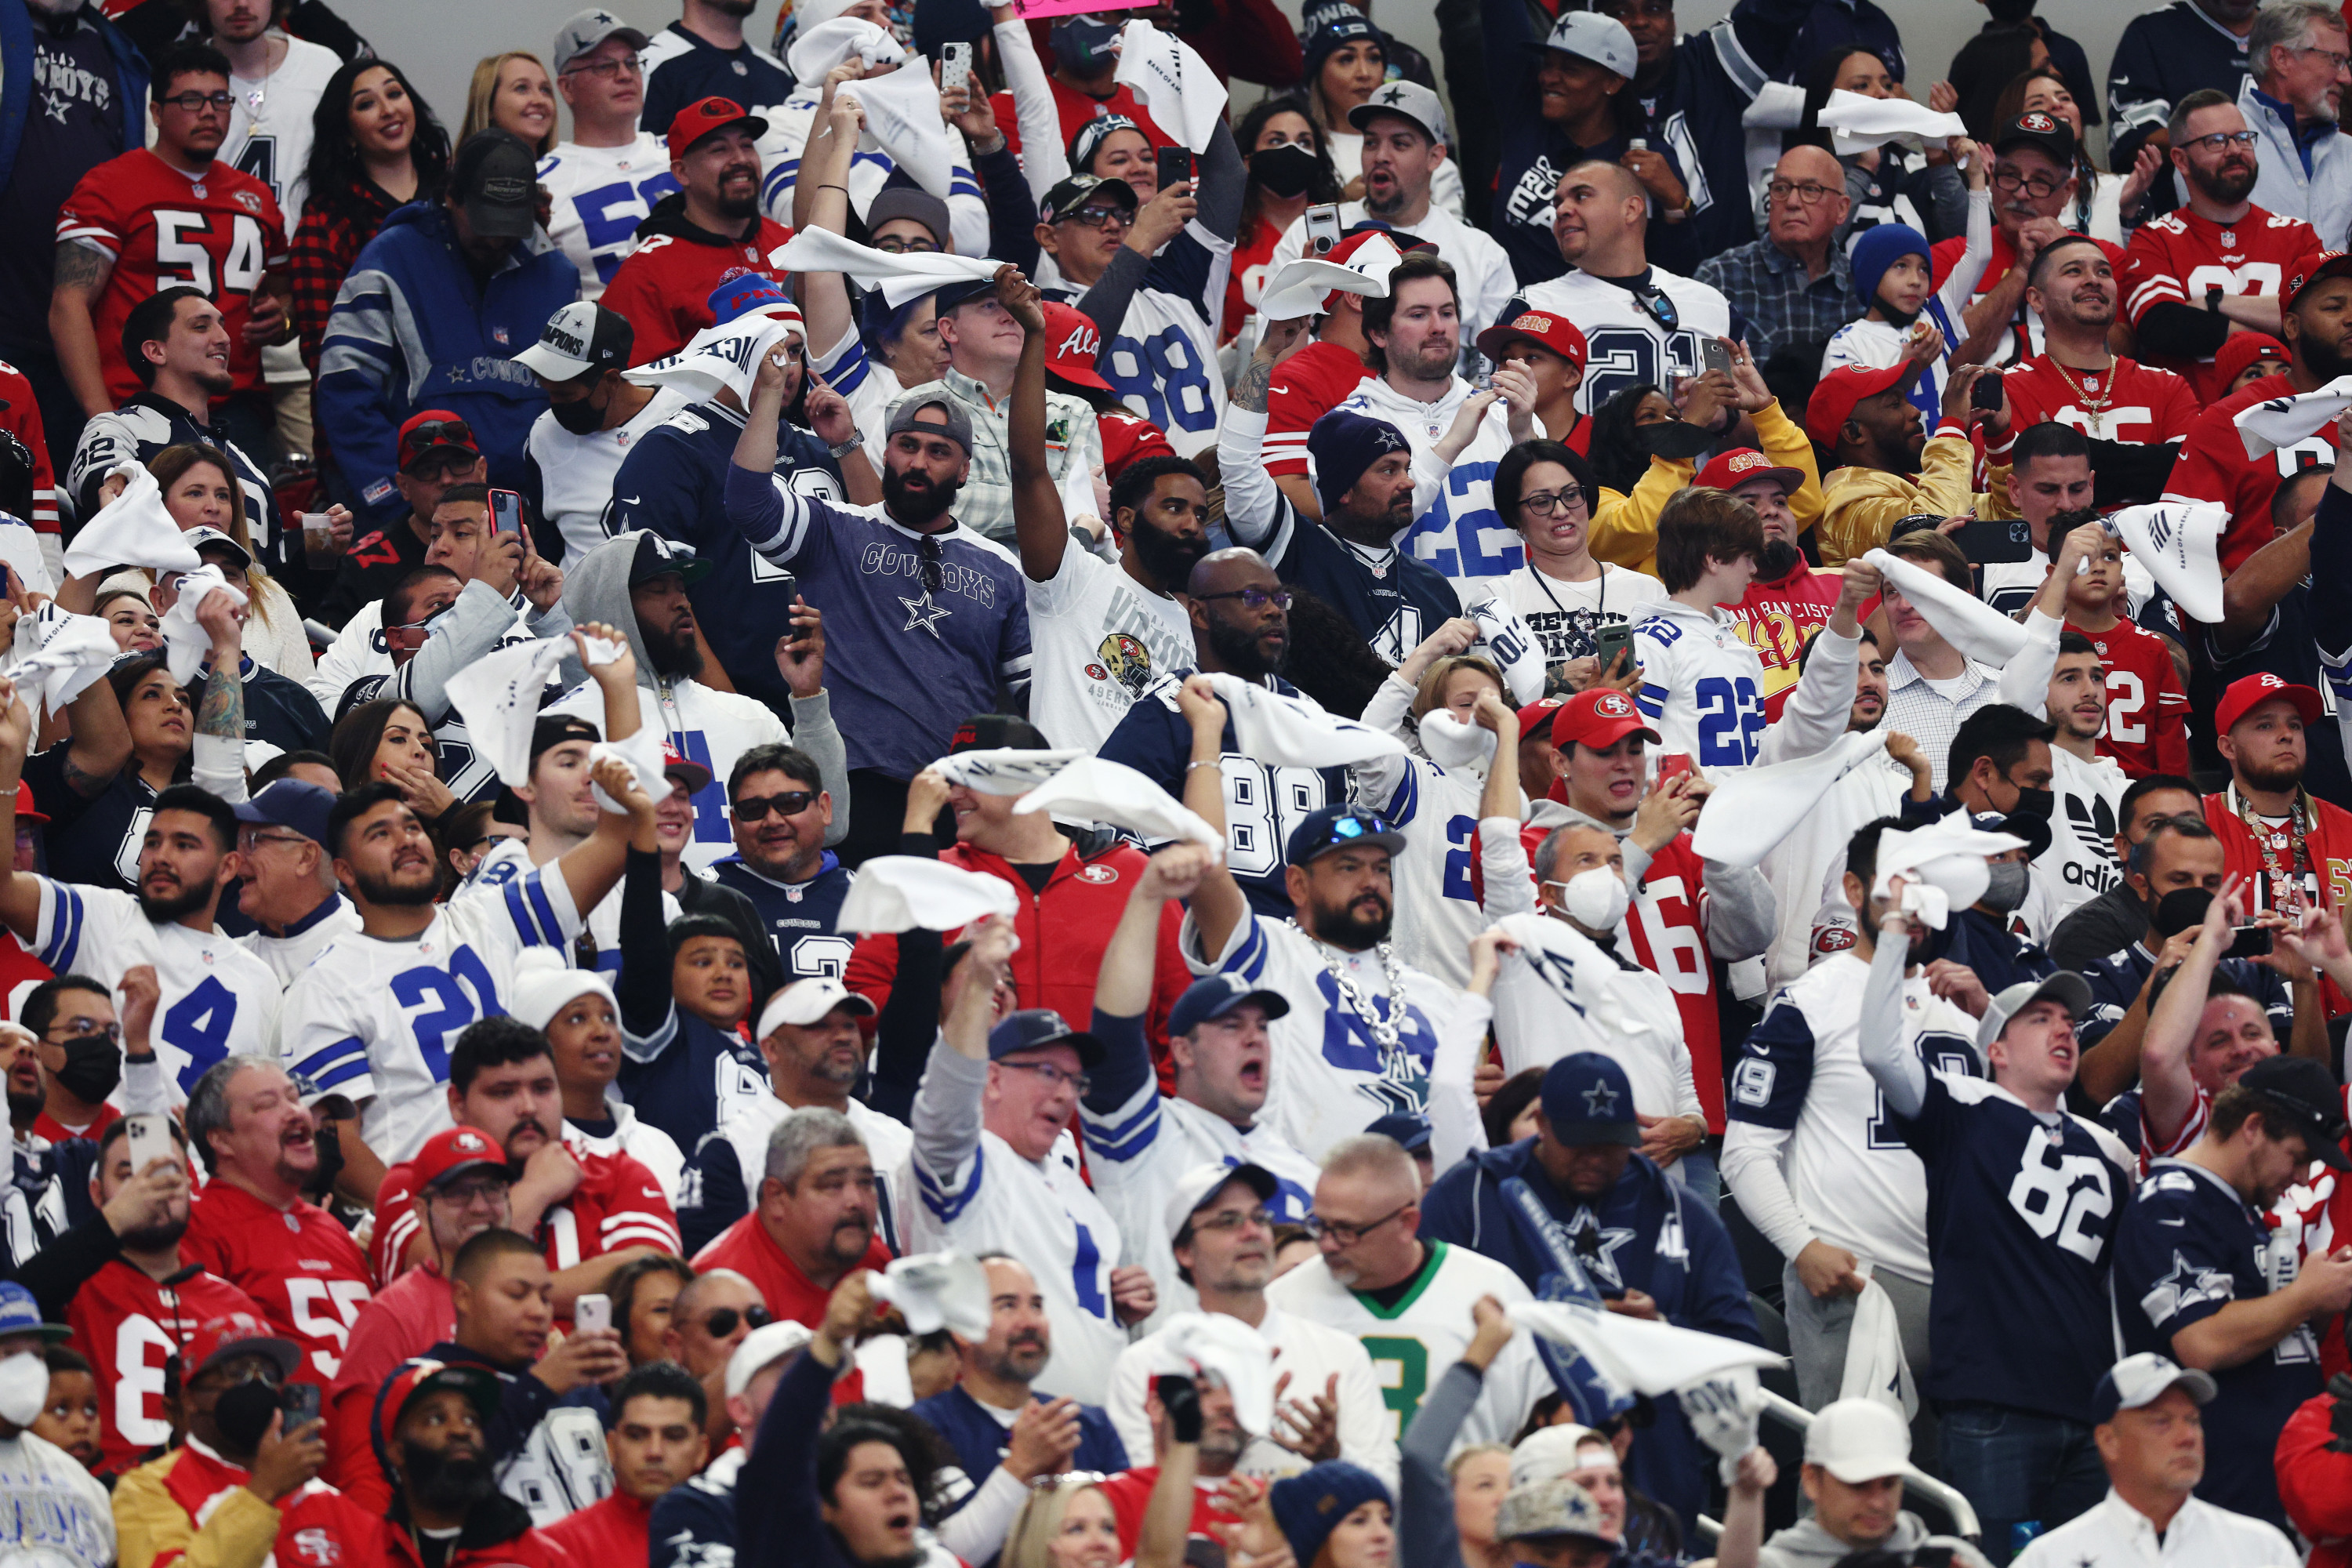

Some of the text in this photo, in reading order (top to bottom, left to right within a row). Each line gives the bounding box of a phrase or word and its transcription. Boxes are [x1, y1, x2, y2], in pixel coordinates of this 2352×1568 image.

[1147, 60, 1182, 96] BANK OF AM
[152, 209, 264, 299] 54
[542, 326, 586, 356] MPIONS
[1056, 325, 1102, 360] Ala
[1585, 327, 1686, 408] 21
[1102, 324, 1218, 433] 88
[1400, 460, 1526, 579] 22
[860, 541, 995, 609] COWOYS
[1089, 684, 1131, 708] 49ERS
[1695, 677, 1762, 766] 22
[2100, 670, 2147, 744] 2
[1221, 755, 1326, 879] 88
[2063, 861, 2123, 895] adi
[776, 918, 821, 931] COWBOYS
[161, 974, 238, 1098] 4
[2007, 1124, 2113, 1263] 82
[2278, 1256, 2293, 1284] ite
